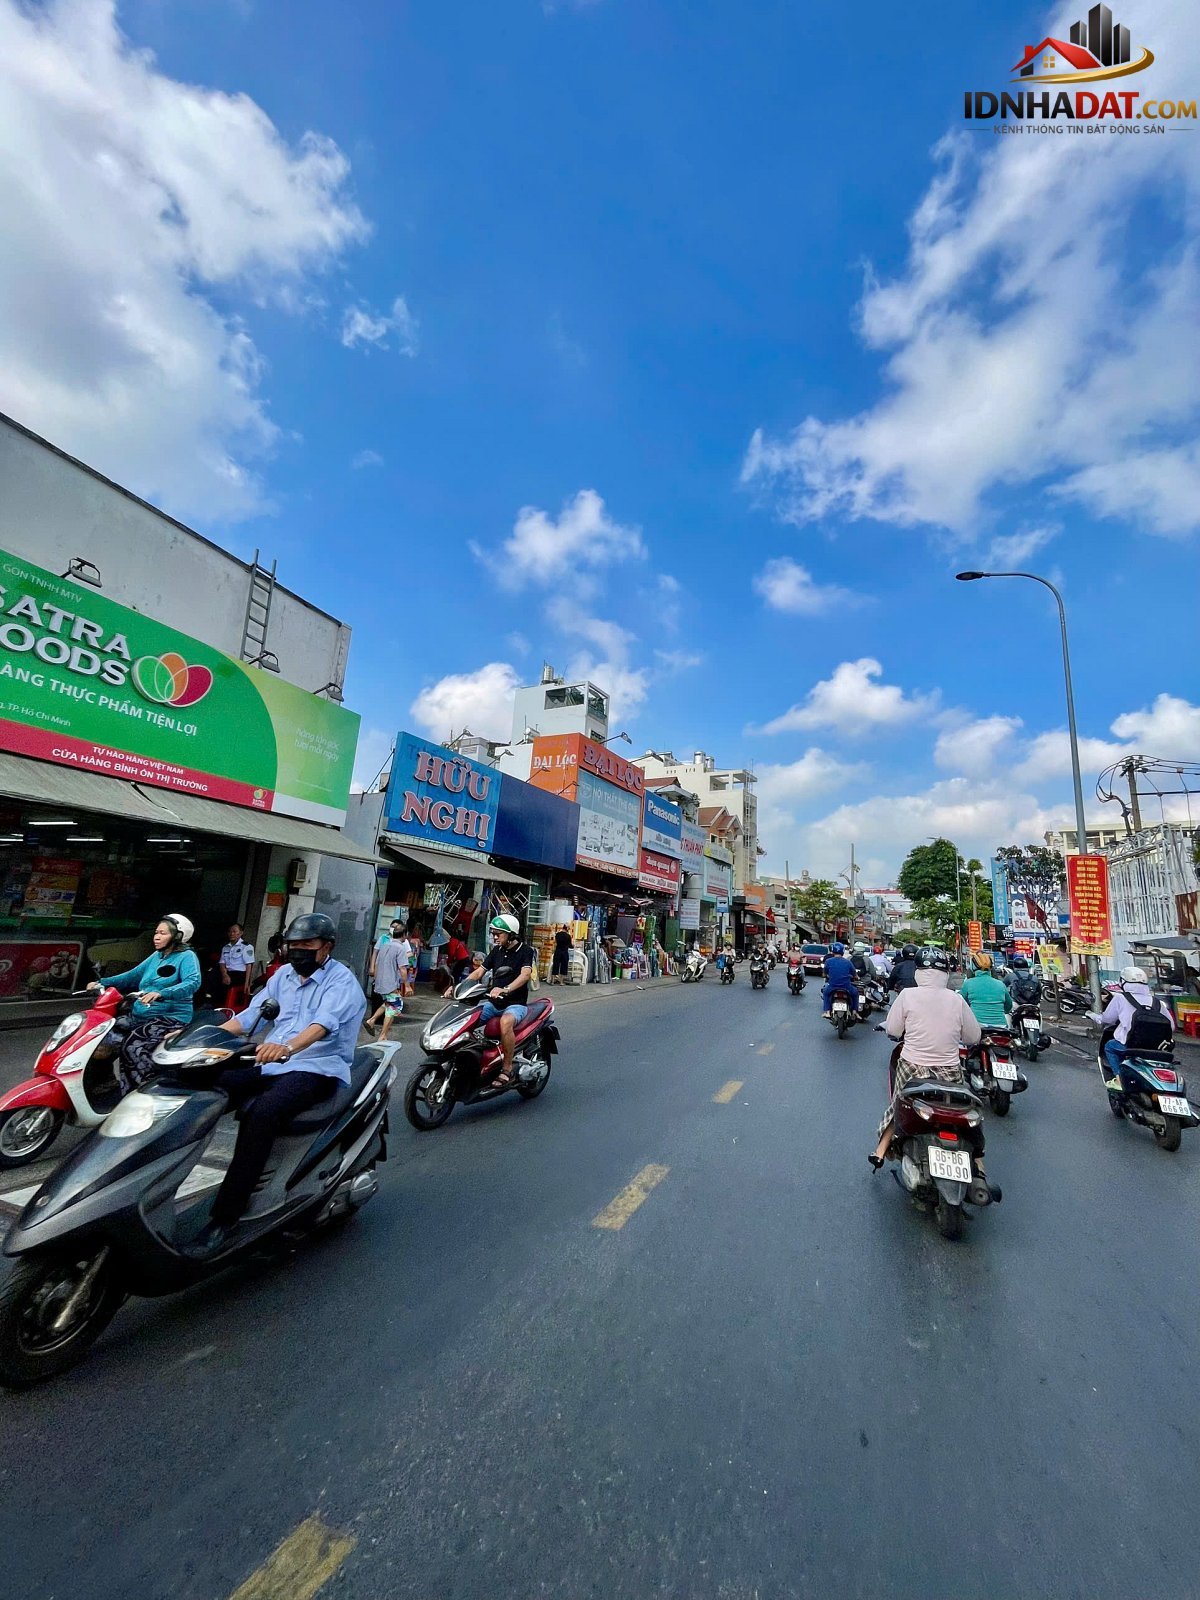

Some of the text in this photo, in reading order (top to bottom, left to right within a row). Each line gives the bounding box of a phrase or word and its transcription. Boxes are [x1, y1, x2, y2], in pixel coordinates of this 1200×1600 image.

[61, 589, 82, 603] MTV
[50, 679, 96, 704] THỰC
[99, 695, 142, 719] PHẨM
[146, 709, 174, 729] TIỆN
[176, 723, 198, 737] LỢI
[52, 747, 78, 761] CỬA
[80, 754, 112, 769] HÀNG
[156, 773, 171, 785] THỊ
[92, 746, 105, 756] TỰ
[150, 760, 167, 772] VIỆT
[167, 765, 184, 775] NAM
[414, 752, 492, 801] HỮU
[401, 791, 492, 848] NGHỊ
[647, 799, 680, 826] Panasonic
[933, 1162, 969, 1179] 150.90
[935, 1150, 963, 1166] 86-B6
